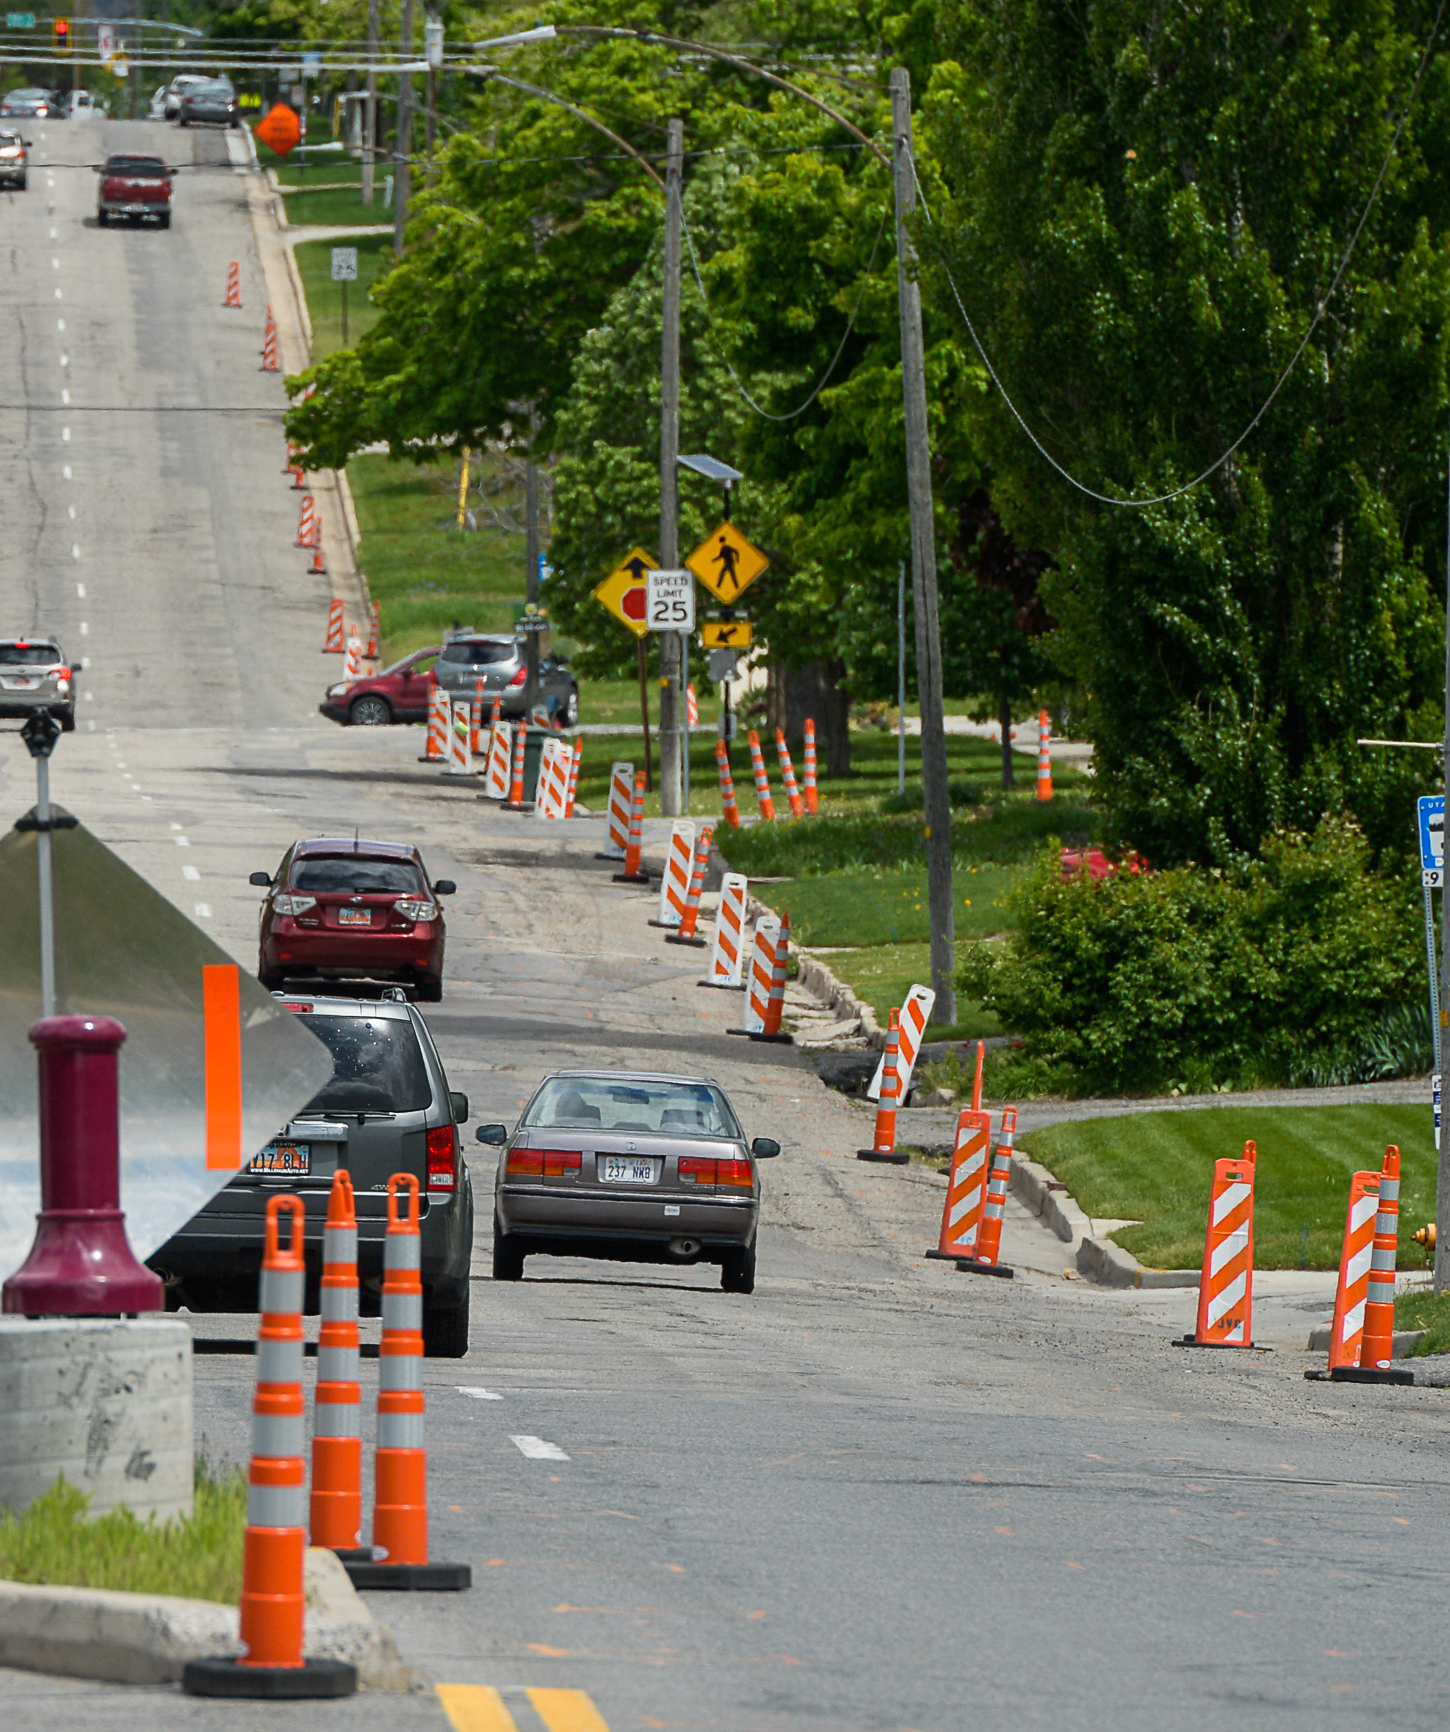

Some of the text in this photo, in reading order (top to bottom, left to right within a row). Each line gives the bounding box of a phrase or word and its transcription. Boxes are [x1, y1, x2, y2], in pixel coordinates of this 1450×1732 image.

[653, 576, 689, 586] SPEED
[657, 588, 684, 598] LIMIT
[653, 600, 688, 622] 25
[1430, 871, 1439, 885] 9
[608, 1165, 627, 1178] 237
